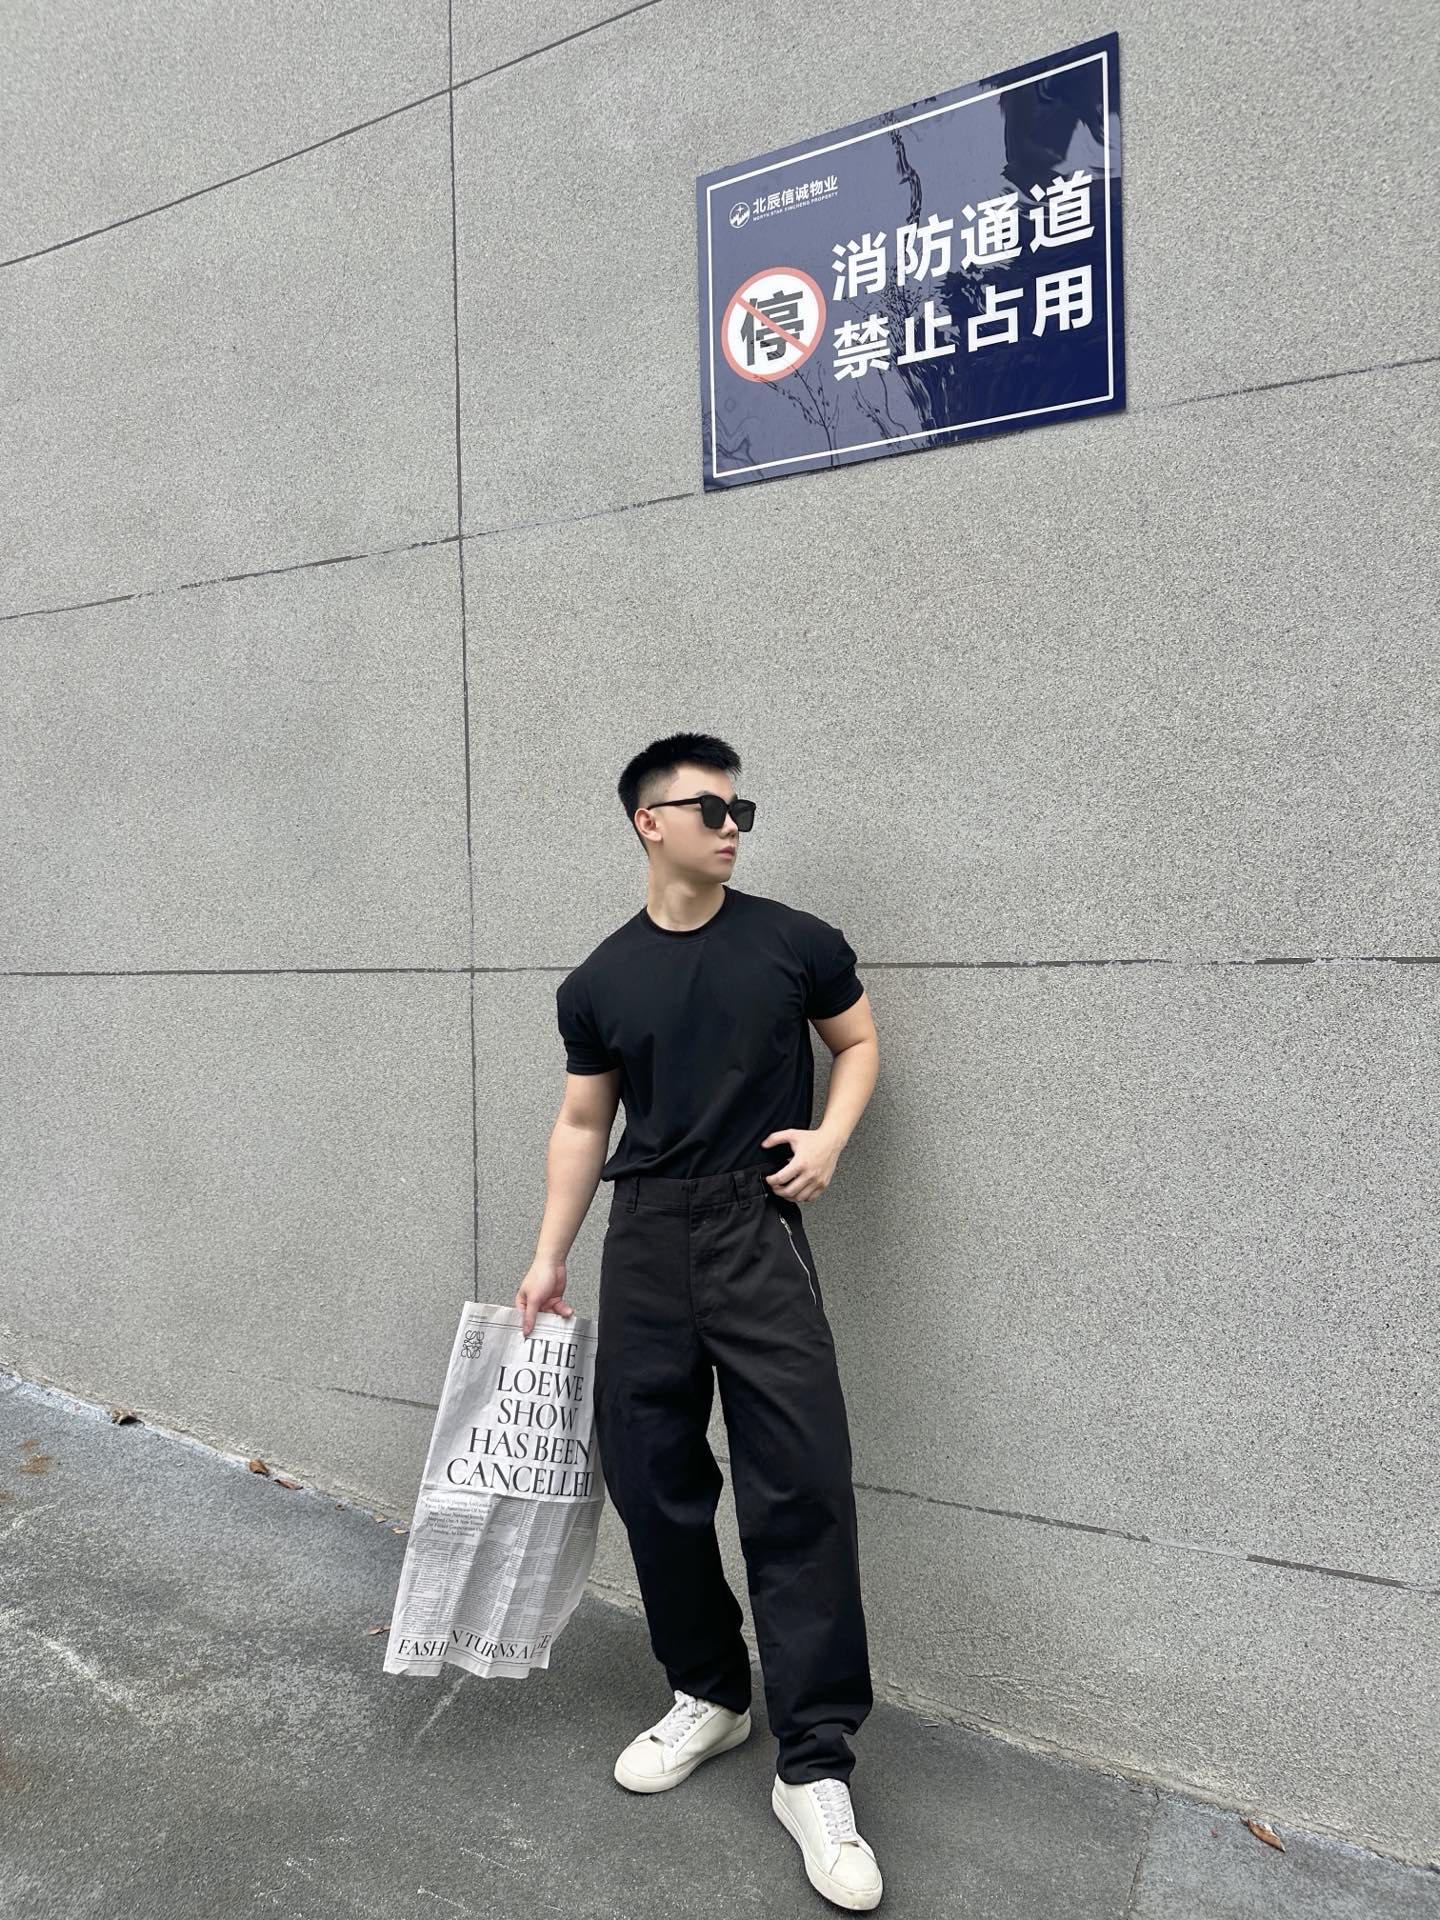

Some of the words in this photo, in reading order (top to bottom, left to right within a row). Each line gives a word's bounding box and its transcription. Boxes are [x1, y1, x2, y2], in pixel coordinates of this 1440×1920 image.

[752, 175, 838, 214] 北辰信诚物业
[753, 213, 770, 221] NORTH
[811, 191, 838, 203] PROPERTY
[831, 170, 1095, 302] 消防通道
[740, 290, 804, 367] 停
[832, 264, 1095, 383] 禁止占用
[523, 1338, 579, 1369] THE
[497, 1366, 584, 1402] LOEWE
[497, 1398, 579, 1432] SHOW
[468, 1427, 528, 1459] HAS
[534, 1435, 592, 1465] BEEN
[465, 1632, 516, 1658] TURNS
[516, 1643, 529, 1659] A
